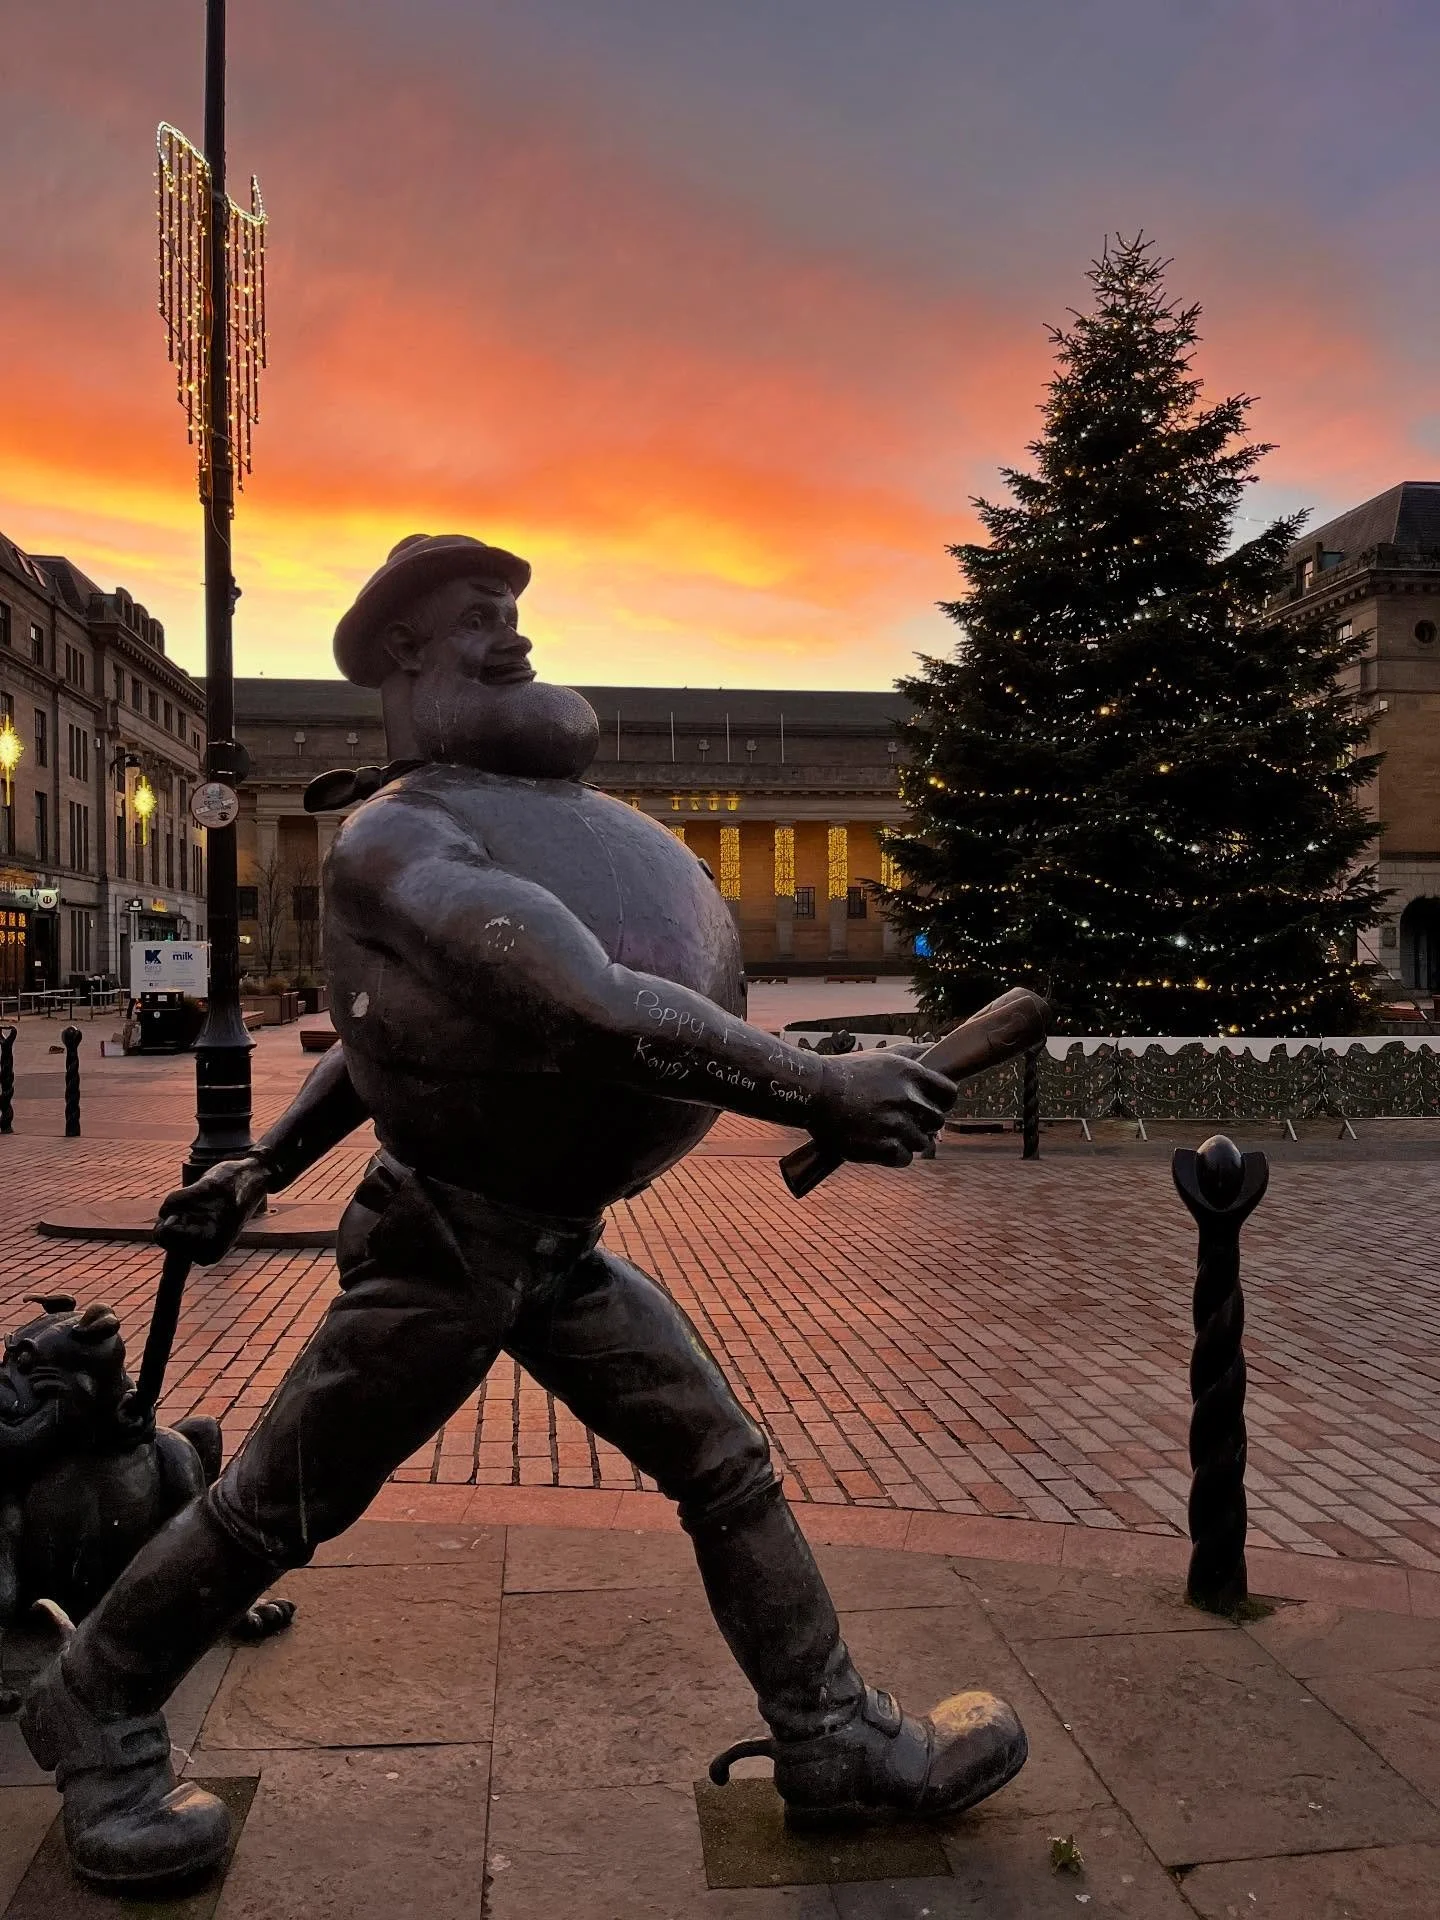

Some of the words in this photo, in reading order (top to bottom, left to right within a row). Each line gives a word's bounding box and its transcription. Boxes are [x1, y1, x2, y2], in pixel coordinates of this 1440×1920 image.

[172, 951, 194, 961] milk
[633, 989, 705, 1039] Poppy
[706, 1060, 756, 1091] Caiden
